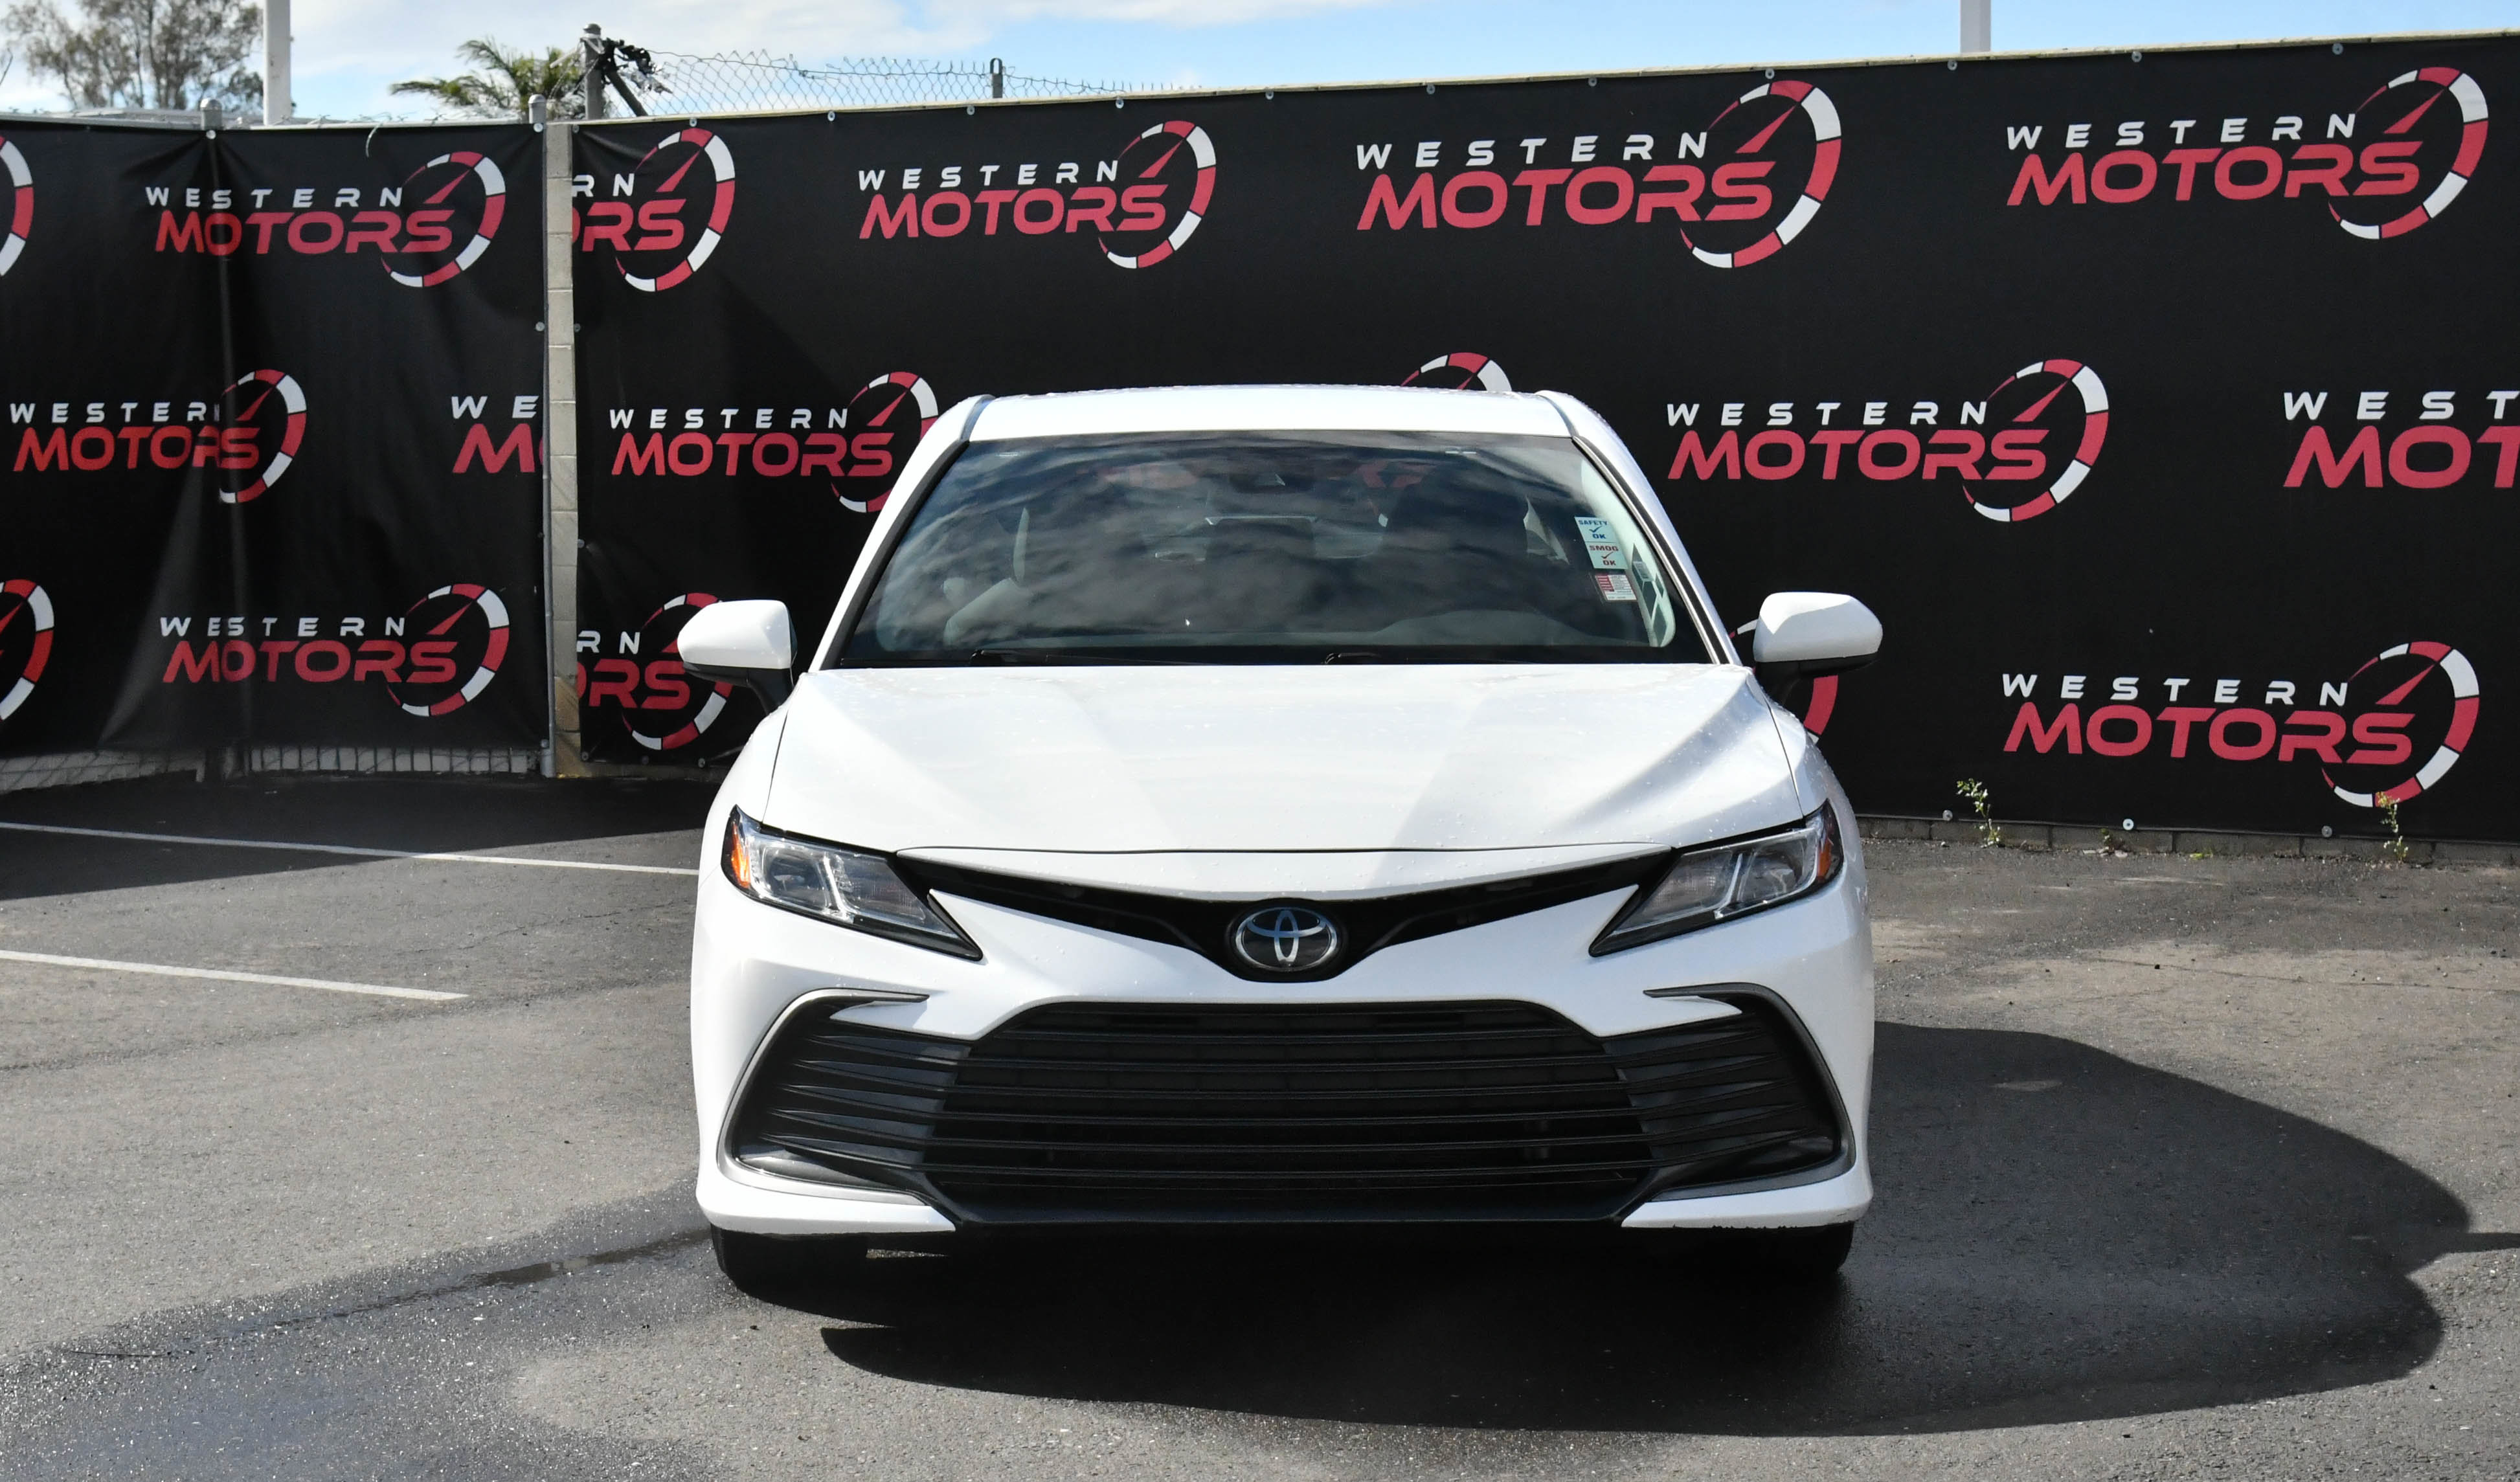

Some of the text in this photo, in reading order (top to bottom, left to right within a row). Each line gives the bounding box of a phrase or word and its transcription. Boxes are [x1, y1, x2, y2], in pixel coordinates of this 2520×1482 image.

[1357, 132, 1707, 170] WESTERN
[2007, 114, 2355, 150] WESTERN
[859, 161, 1118, 190] WESTERN
[2008, 141, 2422, 205] MOTORS
[146, 187, 401, 208] WESTERN
[860, 185, 1167, 238] MOTORS
[1357, 161, 1775, 230] MOTORS
[155, 210, 454, 256] MOTORS
[572, 199, 686, 251] RS
[452, 396, 538, 418] WE
[610, 409, 847, 429] WESTERN
[1667, 401, 1986, 426] WESTERN
[2284, 391, 2520, 420] WEST
[14, 425, 259, 471] MOTORS
[453, 423, 543, 473] M
[612, 432, 894, 477] MOTORS
[1668, 429, 2049, 480] MOTORS
[161, 618, 404, 636] WESTERN
[163, 640, 457, 682] MOTORS
[577, 659, 690, 710] RS
[2003, 674, 2347, 706] WESTERN
[2005, 702, 2414, 765] MOTORS
